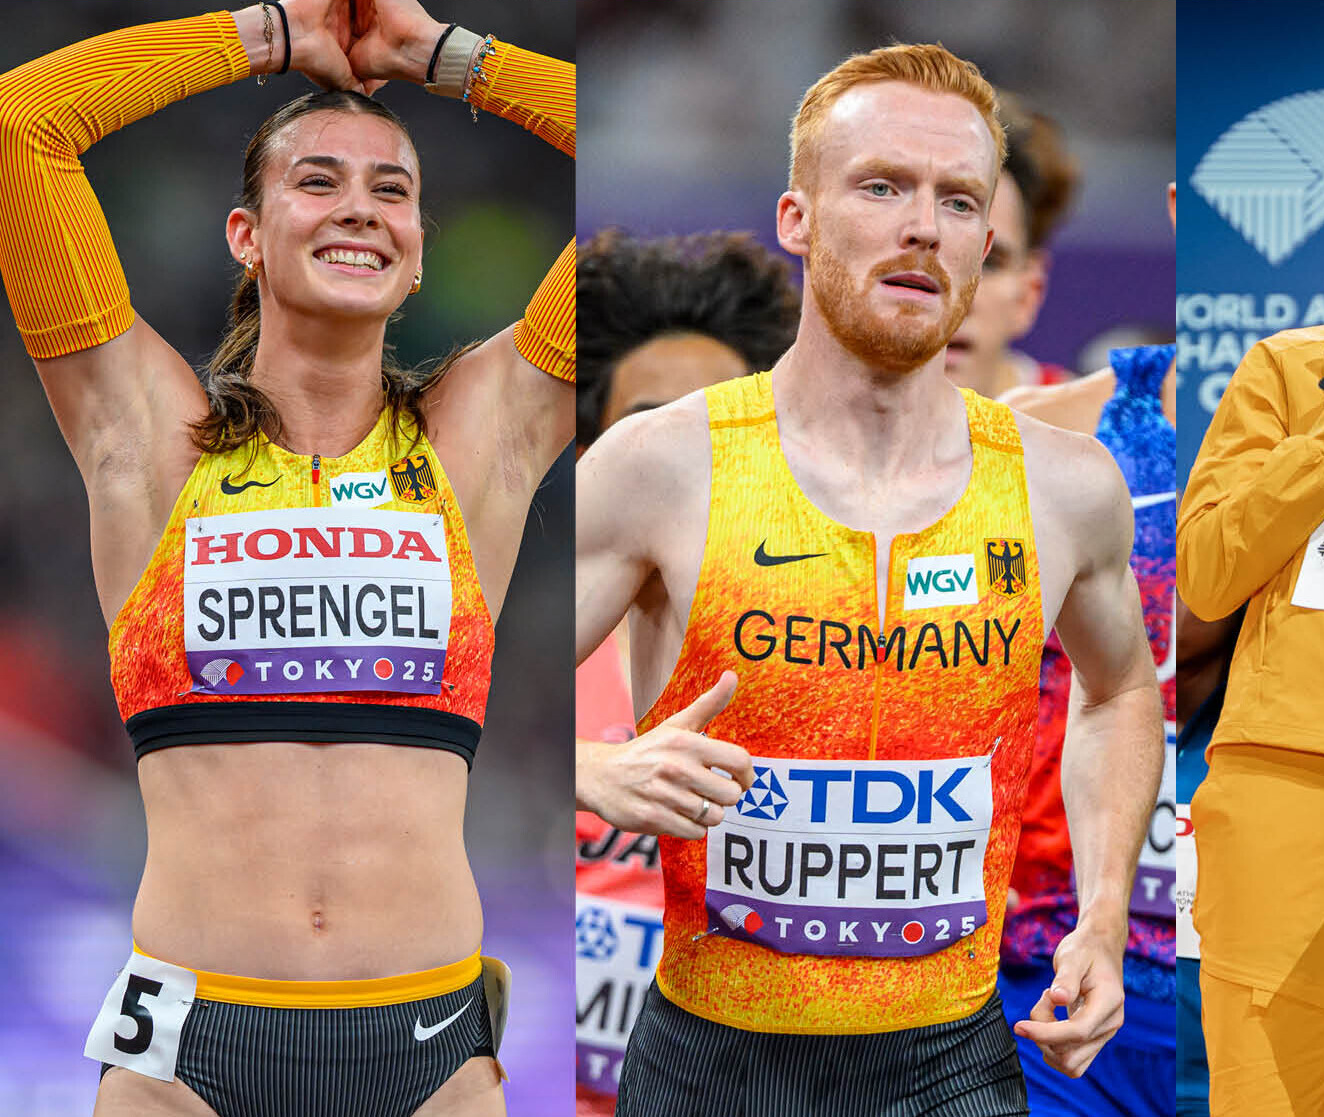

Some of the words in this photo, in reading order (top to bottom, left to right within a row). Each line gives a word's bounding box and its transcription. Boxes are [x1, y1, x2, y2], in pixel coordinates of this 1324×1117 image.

[332, 477, 387, 502] WGV
[191, 526, 442, 566] HONDA
[907, 566, 974, 595] WGV
[197, 583, 440, 642] SPRENGEL
[734, 609, 1021, 672] GERMANY
[789, 766, 974, 824] TDK
[723, 832, 976, 900] RUPPERT
[113, 973, 163, 1055] 5
